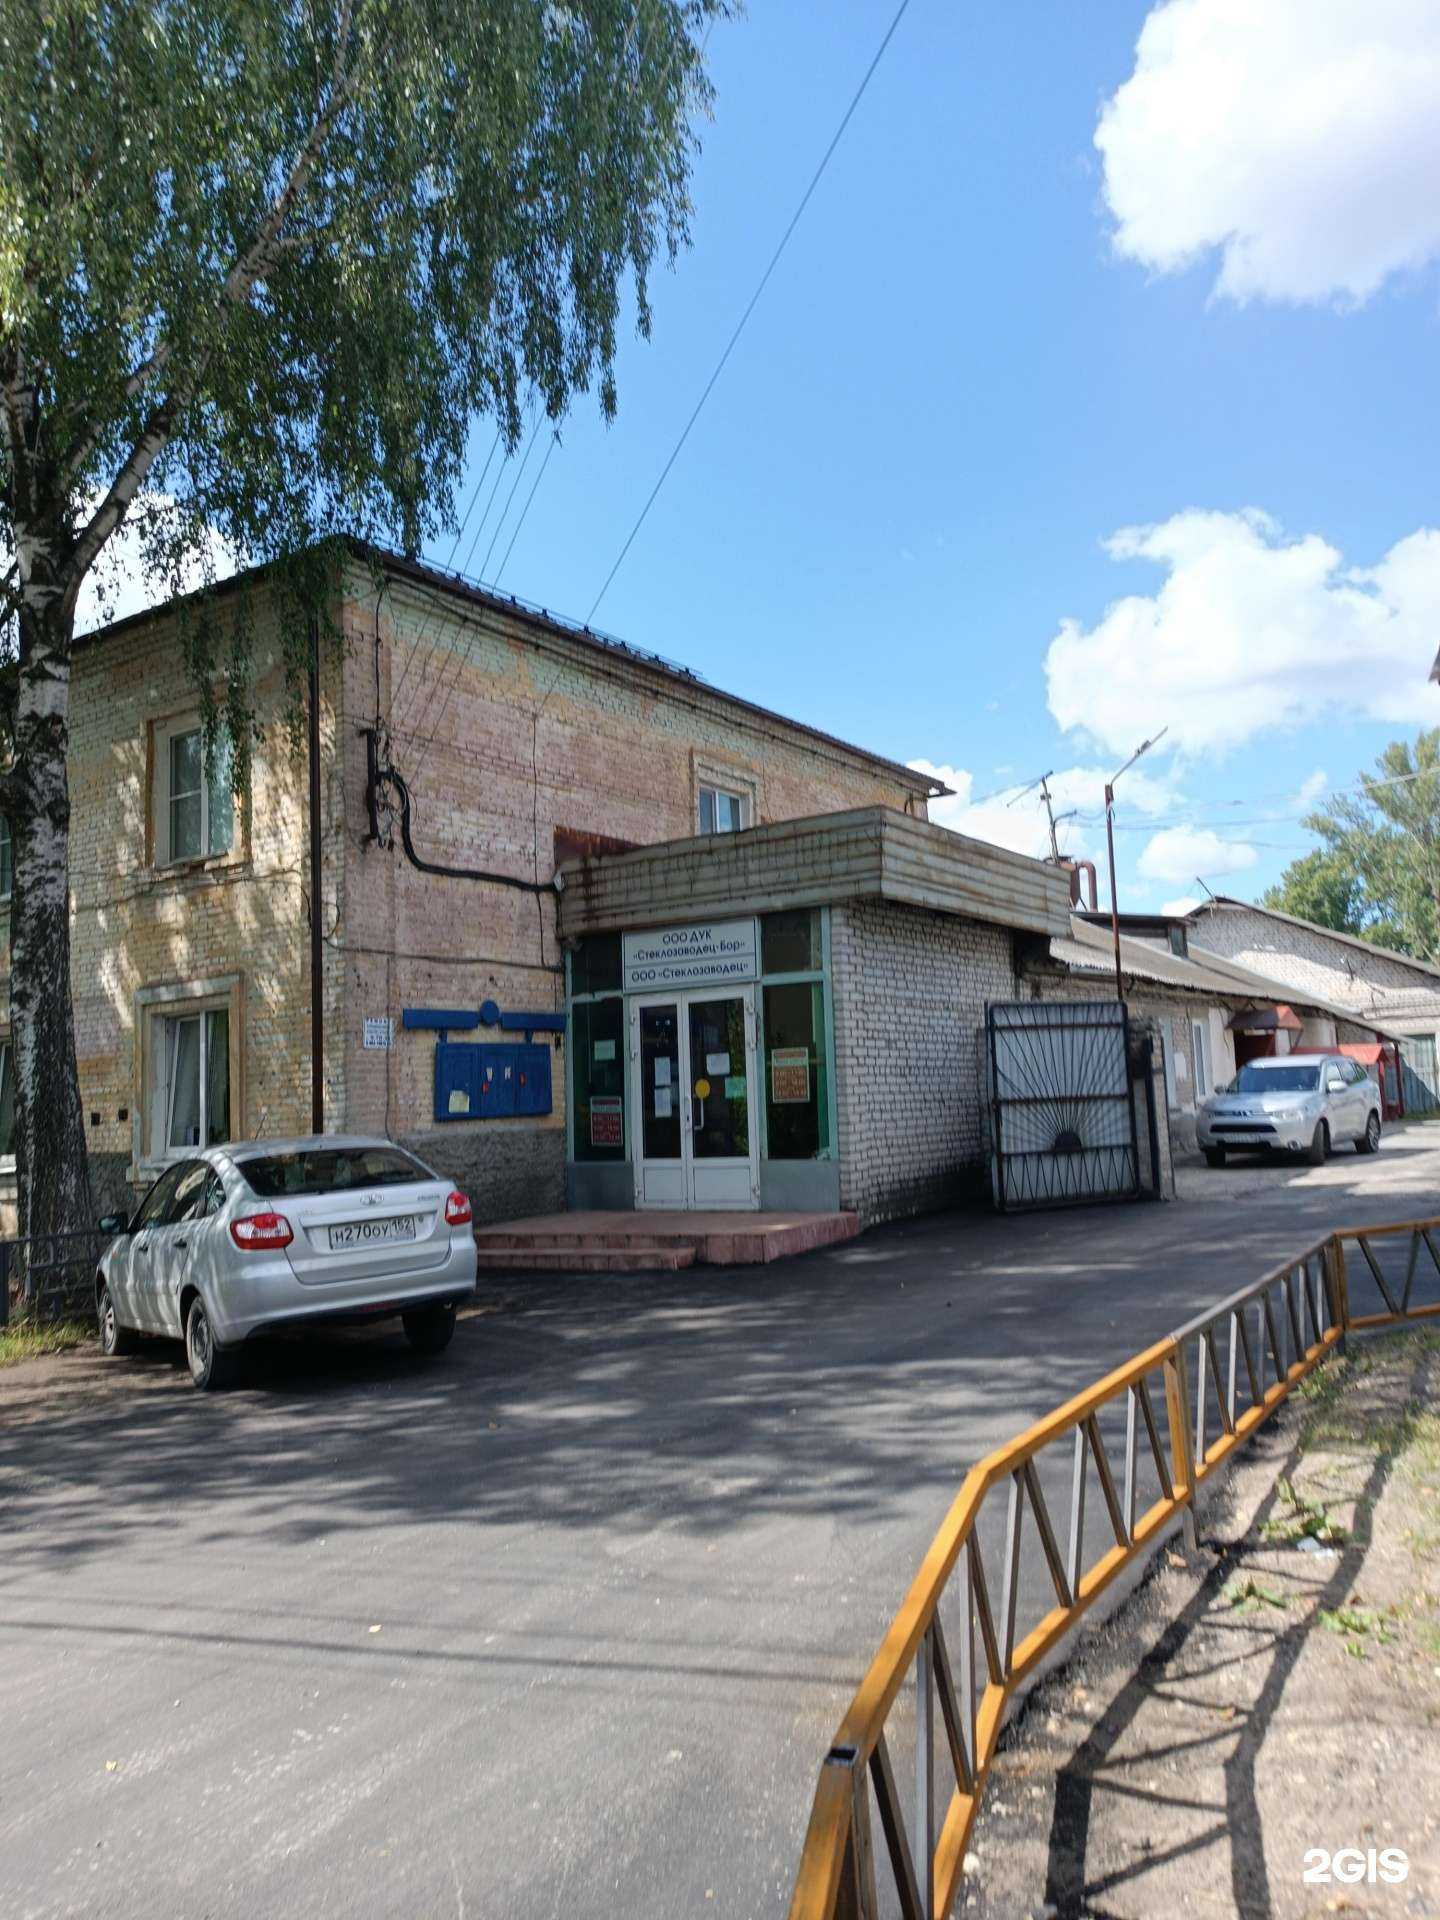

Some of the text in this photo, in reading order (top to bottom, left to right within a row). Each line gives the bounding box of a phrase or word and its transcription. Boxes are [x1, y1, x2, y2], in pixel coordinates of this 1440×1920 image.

[662, 928, 712, 945] ООО ДУК
[631, 968, 656, 983] ООО
